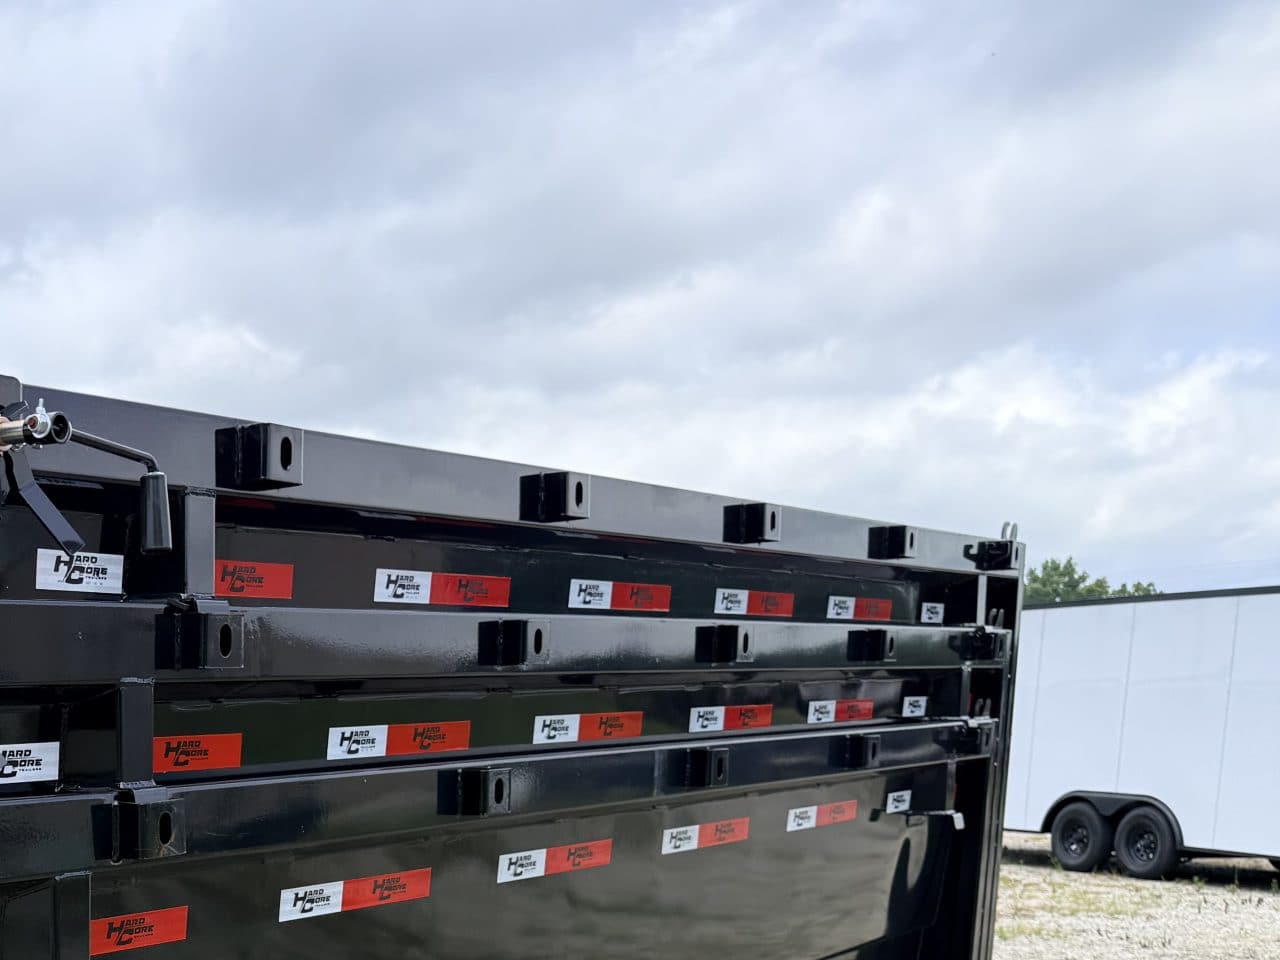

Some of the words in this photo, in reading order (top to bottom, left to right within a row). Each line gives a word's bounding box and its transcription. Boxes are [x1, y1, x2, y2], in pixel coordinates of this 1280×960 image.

[54, 555, 97, 572] HARD
[65, 566, 107, 584] CORE
[221, 565, 256, 582] HARD
[385, 574, 414, 590] HARD
[339, 730, 369, 746] HARD
[347, 738, 376, 754] CORE
[164, 741, 201, 758] HARD
[173, 749, 209, 766] CORE
[292, 888, 324, 907] HARD
[301, 896, 331, 913] CORE
[106, 918, 145, 939] HARD
[116, 925, 154, 945] CORE
